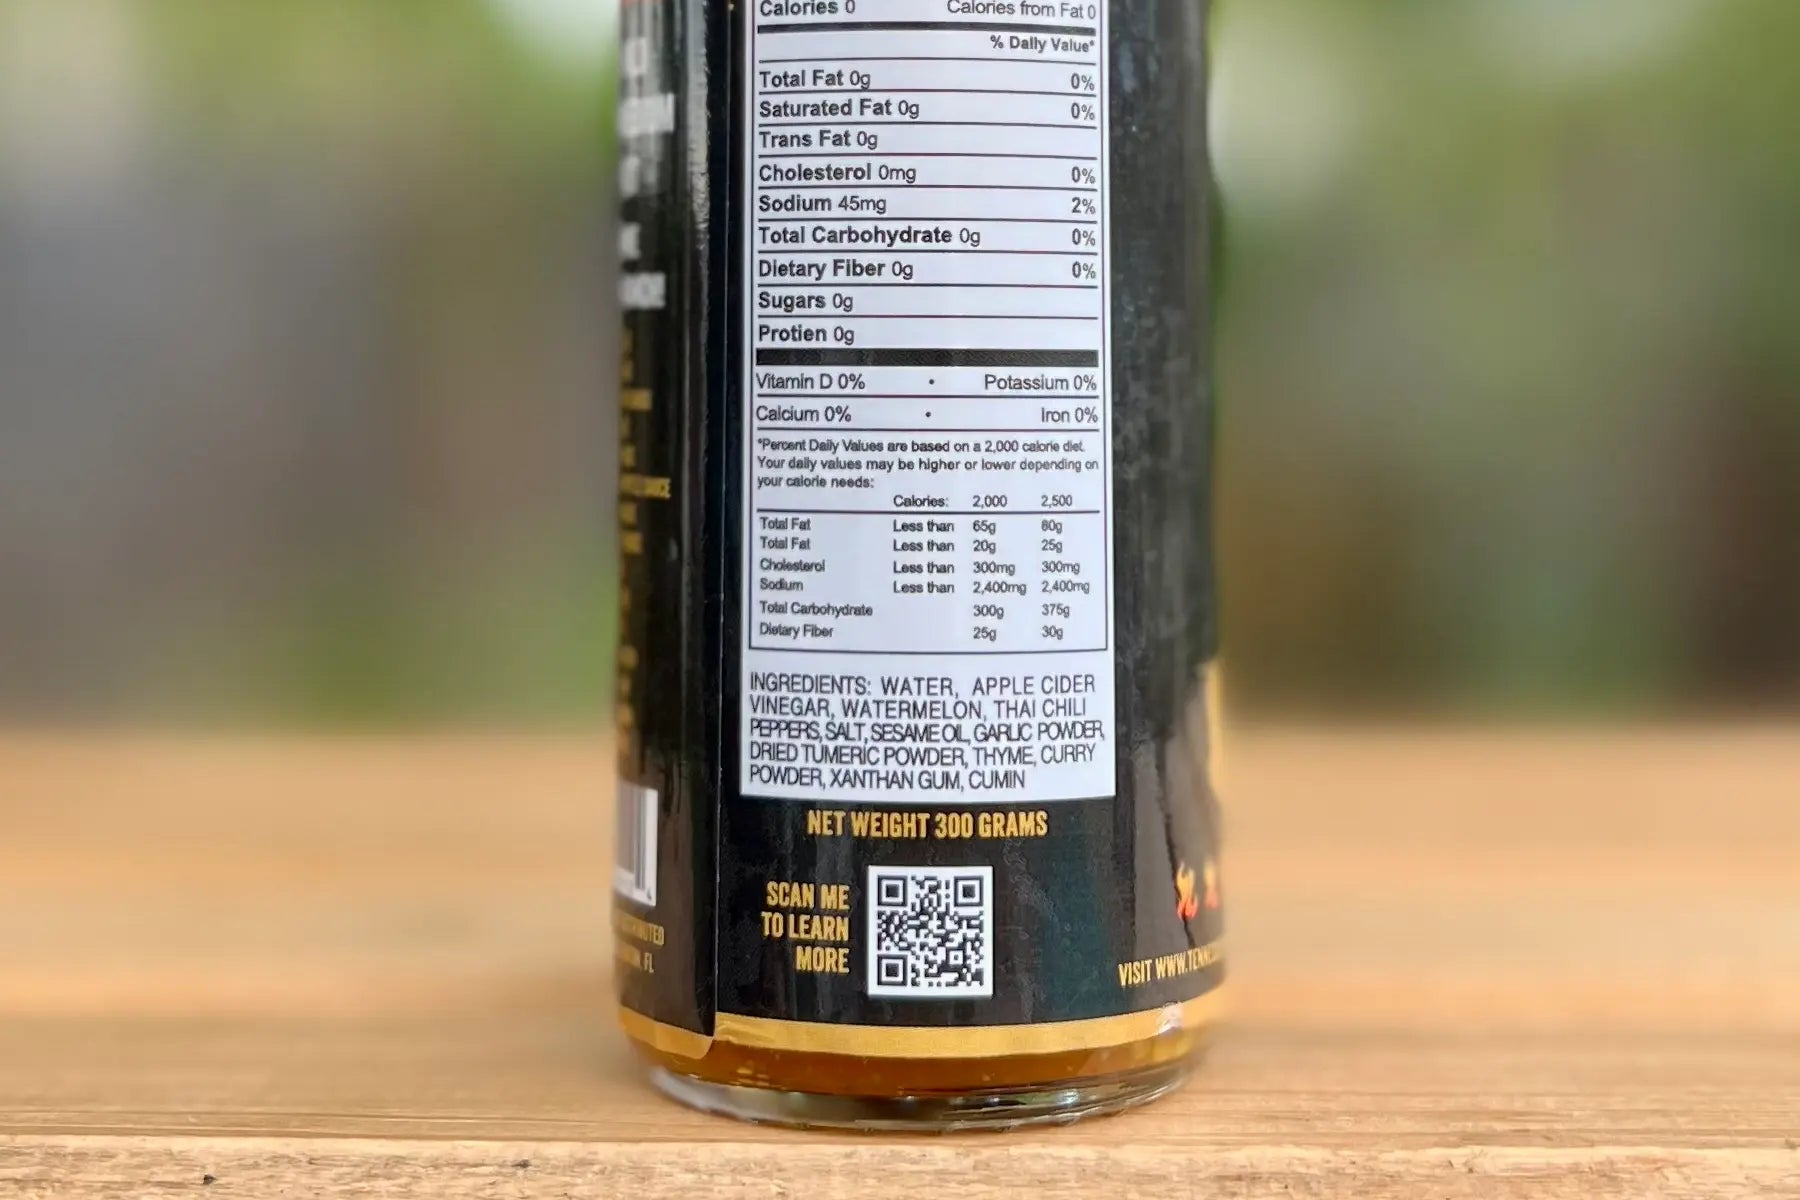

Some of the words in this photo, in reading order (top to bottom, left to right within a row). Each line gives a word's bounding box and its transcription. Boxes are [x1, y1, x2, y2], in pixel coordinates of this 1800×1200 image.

[760, 0, 838, 17] Calories
[845, 0, 855, 13] 0
[1020, 3, 1055, 17] from
[1060, 4, 1084, 19] Fat
[1087, 5, 1096, 19] 0
[990, 36, 1004, 49] %
[759, 69, 805, 88] Total
[812, 70, 844, 86] Fat
[850, 70, 871, 88] 0g
[1071, 73, 1095, 91] 0%
[759, 100, 852, 118] Saturated
[860, 100, 892, 116] Fat
[898, 100, 919, 119] 0g
[1071, 103, 1095, 120] 0%
[759, 131, 812, 148] Trans
[820, 130, 851, 146] Fat
[857, 131, 878, 149] 0g
[759, 164, 871, 182] Cholesterol
[879, 164, 916, 183] 0mg
[1071, 167, 1096, 184] 0%
[758, 195, 832, 212] Sodium
[838, 196, 887, 215] 45mg
[1071, 198, 1096, 215] 2%
[758, 225, 805, 244] Total
[812, 226, 952, 247] Carbohydrate
[960, 228, 980, 246] 0g
[1071, 228, 1096, 246] 0%
[758, 260, 827, 280] Dietary
[833, 259, 885, 277] Fiber
[891, 261, 913, 279] 0g
[1072, 262, 1096, 279] 0%
[758, 292, 826, 313] Sugars
[833, 292, 853, 312] 0g
[758, 325, 827, 342] Protien
[833, 326, 855, 345] 0g
[756, 373, 814, 390] Vitamin
[820, 374, 833, 389] D
[838, 374, 865, 390] 0%
[985, 374, 1069, 391] Potassium
[1074, 374, 1096, 391] 0%
[756, 406, 819, 422] Calcium
[825, 406, 851, 422] 0%
[1041, 407, 1070, 423] Iron
[1074, 407, 1098, 424] 0%
[809, 439, 839, 454] Daily
[842, 440, 884, 452] Values
[887, 443, 907, 452] are
[912, 440, 950, 453] based
[954, 443, 970, 453] on
[973, 443, 981, 453] a
[985, 440, 1018, 454] 2,000
[1022, 440, 1059, 453] calorie
[757, 457, 785, 470] Your
[788, 457, 816, 472] daily
[820, 458, 862, 470] values
[866, 460, 893, 473] may
[898, 459, 915, 470] be
[919, 459, 960, 473] higher
[964, 461, 977, 470] or
[982, 459, 1016, 470] lower
[1020, 459, 1081, 473] depending
[1085, 460, 1099, 470] on
[757, 476, 783, 489] your
[786, 476, 826, 488] calorie
[831, 476, 874, 488] needs:
[893, 495, 948, 507] Calories:
[973, 495, 1008, 508] 2,000
[1041, 495, 1073, 508] 2,500
[760, 517, 788, 530] Total
[791, 518, 811, 530] Fat
[893, 520, 923, 532] Less
[926, 520, 954, 532] than
[760, 537, 788, 550] Total
[791, 538, 810, 550] Fat
[893, 539, 923, 552] Less
[926, 539, 954, 552] than
[973, 540, 996, 554] 20g
[1042, 539, 1062, 554] 25g
[760, 559, 826, 572] Cholesterol
[893, 561, 923, 574] Less
[926, 561, 954, 574] than
[973, 562, 1016, 576] 300mg
[1042, 561, 1080, 576] 300mg
[760, 578, 804, 591] Sodium
[893, 582, 923, 594] Less
[926, 582, 954, 594] than
[973, 582, 1027, 596] 2,400mg
[1042, 580, 1090, 595] 2,400mg
[759, 601, 788, 614] Total
[790, 602, 873, 618] Carbohydrate
[973, 605, 1004, 620] 300g
[1042, 603, 1070, 618] 375g
[760, 622, 799, 639] Dietary
[803, 624, 833, 637] Fiber
[973, 626, 997, 641] 25g
[1042, 625, 1064, 640] 30g
[750, 672, 872, 696] INGREDIENTS:
[881, 676, 959, 699] WATER,
[972, 676, 1035, 696] APPLE
[1041, 674, 1096, 695] CIDER
[750, 695, 835, 720] VINEGAR,
[842, 700, 987, 721] WATERMELON,
[994, 698, 1036, 718] THAI
[1041, 698, 1086, 717] CHILI
[750, 718, 823, 744] PEPPERS,
[825, 721, 868, 744] SALT,
[871, 722, 941, 742] SESAME
[942, 723, 971, 746] OIL,
[974, 721, 1032, 741] GARLIC
[1037, 719, 1105, 741] POWDER,
[750, 743, 798, 762] DRIED
[801, 744, 880, 766] TUMERIC
[884, 747, 968, 769] POWDER,
[973, 746, 1037, 768] THYME,
[1040, 743, 1096, 763] CURRY
[750, 764, 826, 790] POWDER,
[830, 766, 914, 790] XANTHAN
[918, 769, 964, 791] GUM,
[807, 810, 846, 836] NET
[850, 811, 930, 838] WEIGHT
[935, 813, 974, 839] 300
[979, 810, 1048, 838] GRAMS
[767, 881, 815, 909] SCAN
[820, 884, 849, 911] ME
[761, 911, 784, 938] TO
[788, 913, 849, 942] LEARN
[795, 947, 849, 974] MORE
[1118, 959, 1153, 987] VISIT
